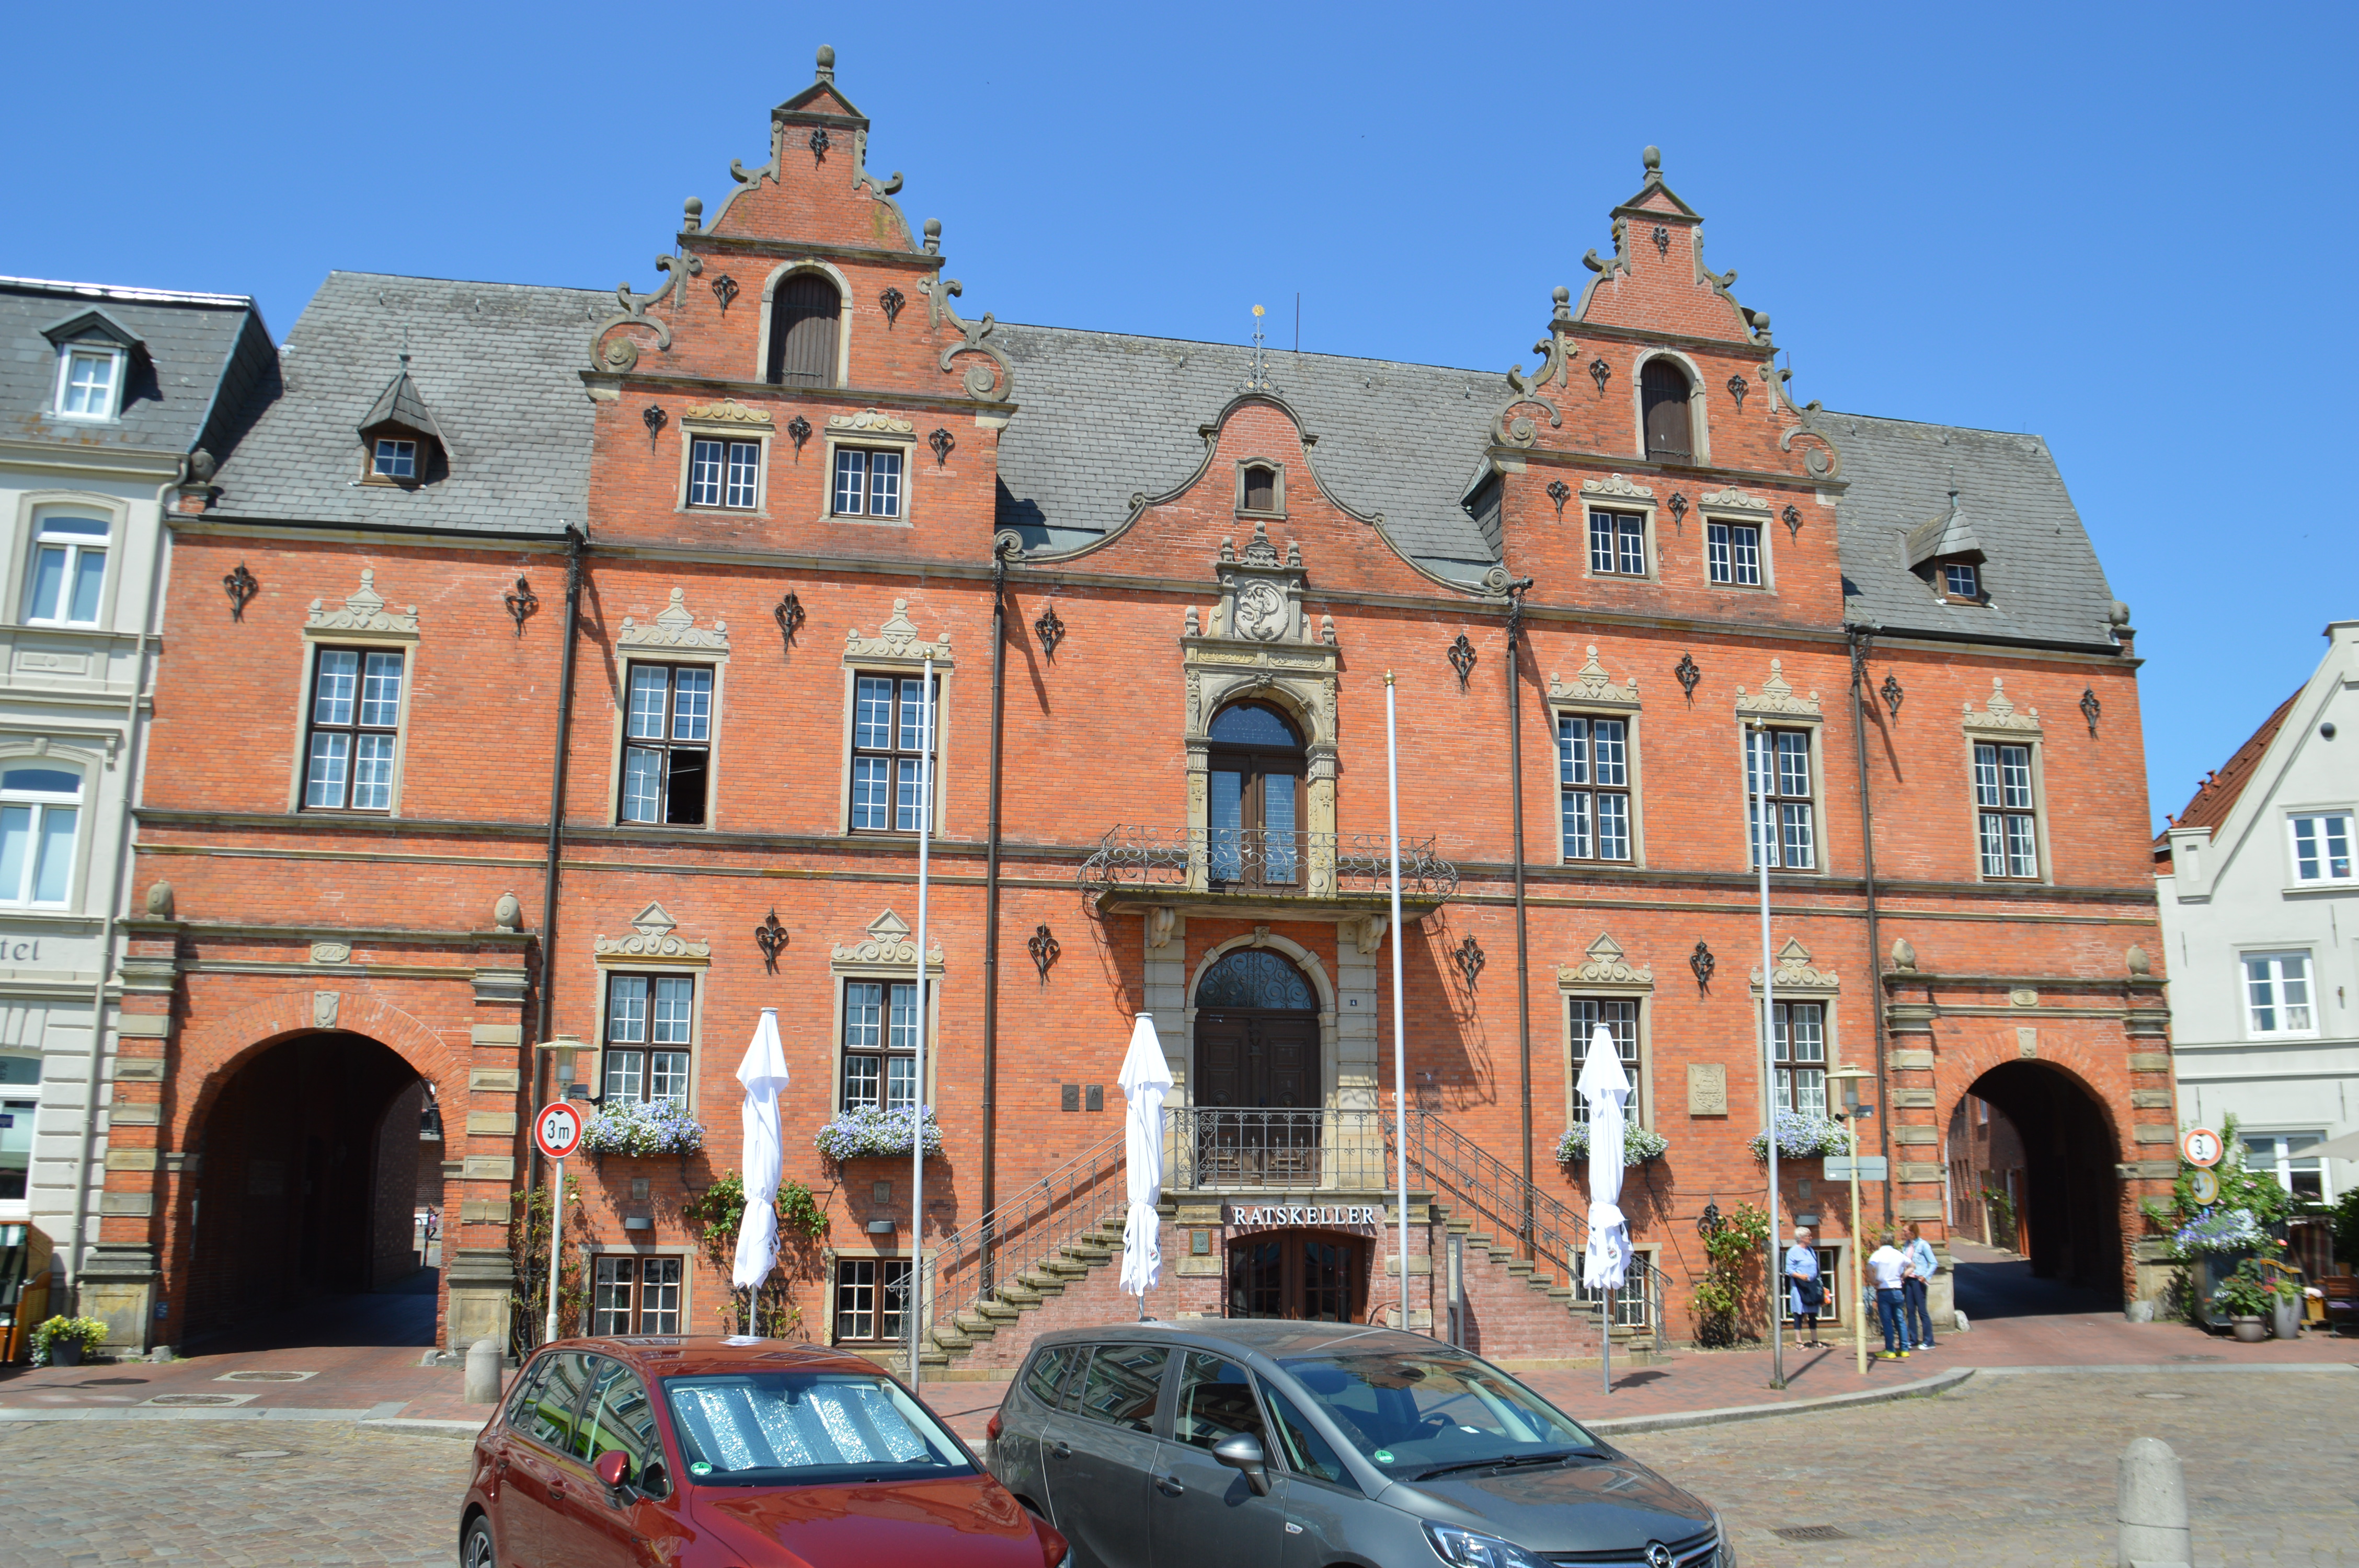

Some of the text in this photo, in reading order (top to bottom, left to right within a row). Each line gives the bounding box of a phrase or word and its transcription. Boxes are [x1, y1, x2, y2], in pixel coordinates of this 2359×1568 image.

[547, 1120, 569, 1139] 3 m
[2195, 1139, 2203, 1155] 3
[1233, 1206, 1375, 1225] RATSKELLER
